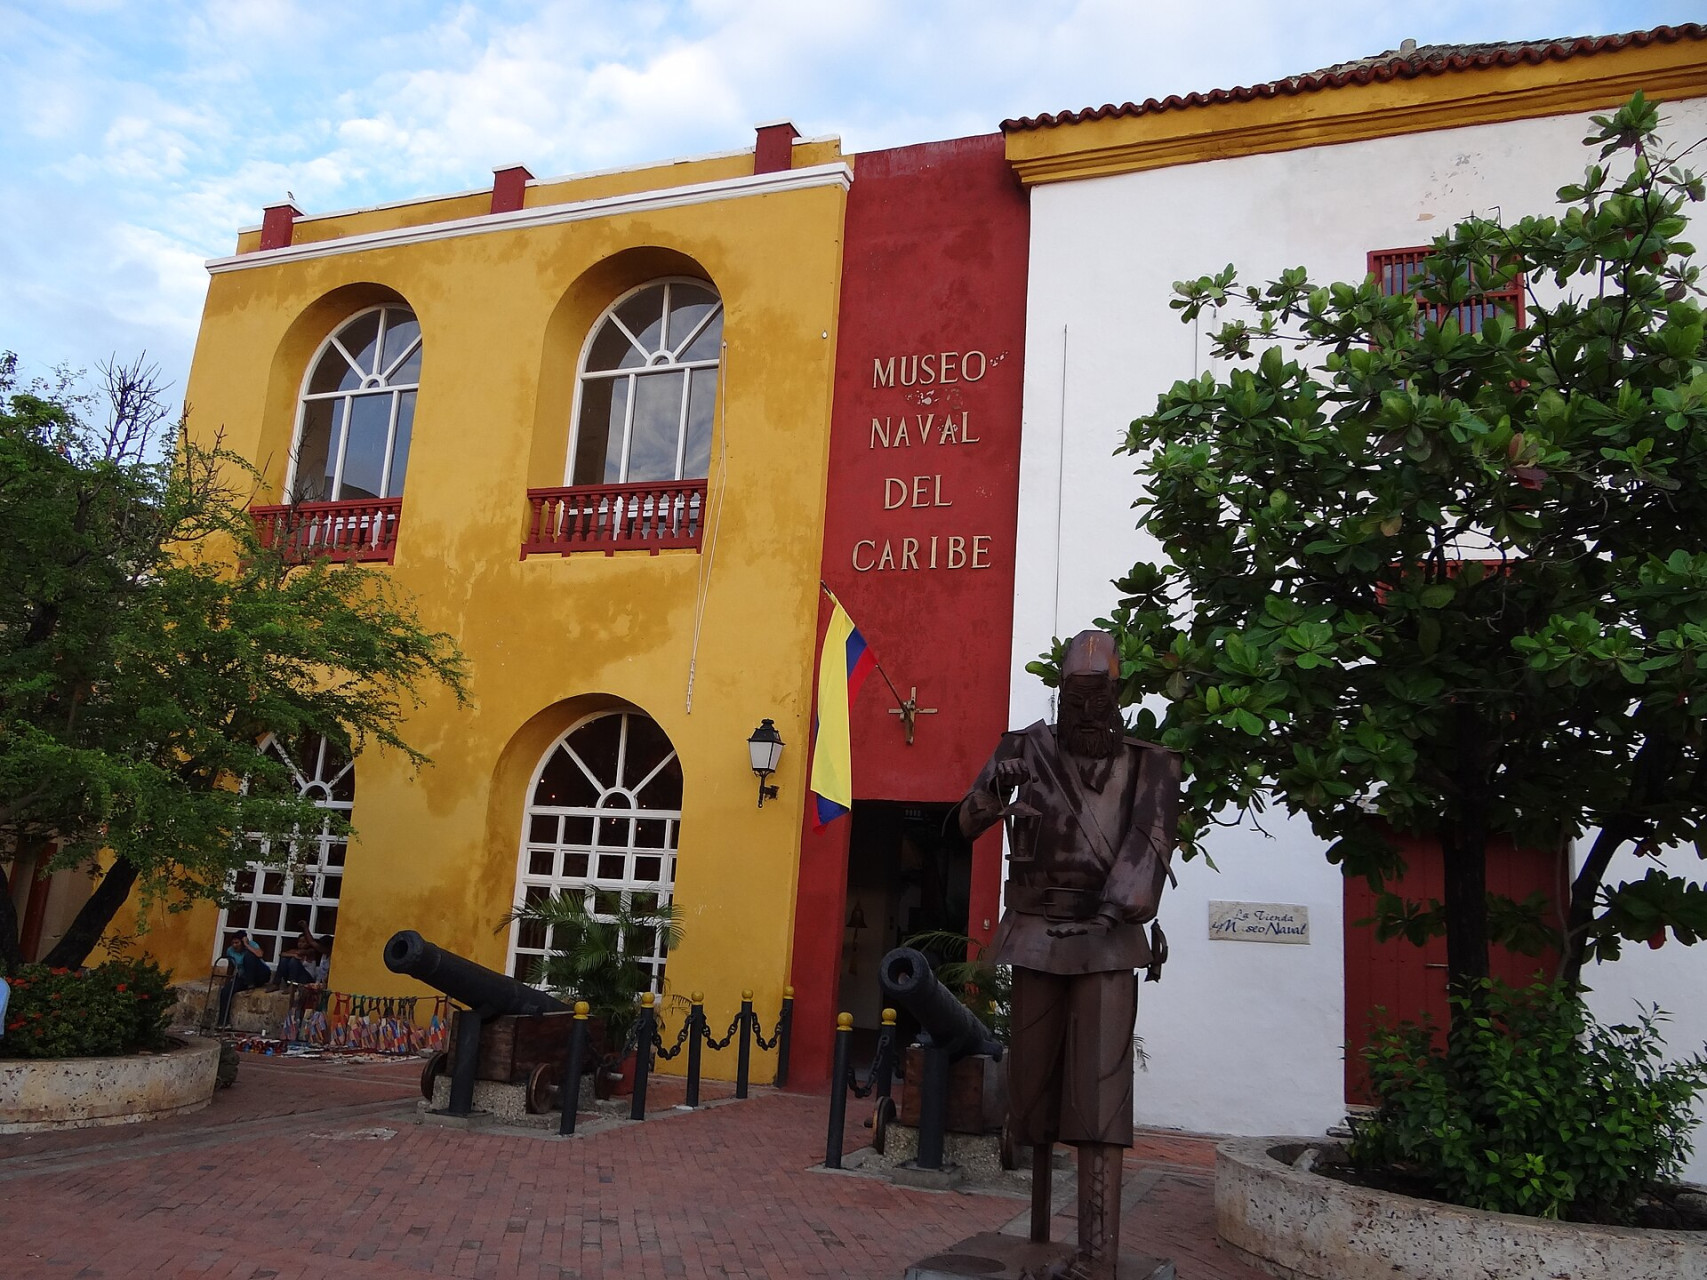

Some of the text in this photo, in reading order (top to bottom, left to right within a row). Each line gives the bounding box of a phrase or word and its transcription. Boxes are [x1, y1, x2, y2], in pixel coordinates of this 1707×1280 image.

[873, 350, 987, 388] MUSEO
[870, 411, 980, 449] NAVAL
[884, 474, 953, 510] DEL
[852, 535, 992, 572] CARIBE
[1219, 919, 1266, 934] Mseo
[1265, 922, 1307, 935] Naval
[1233, 908, 1294, 922] La Tienda
